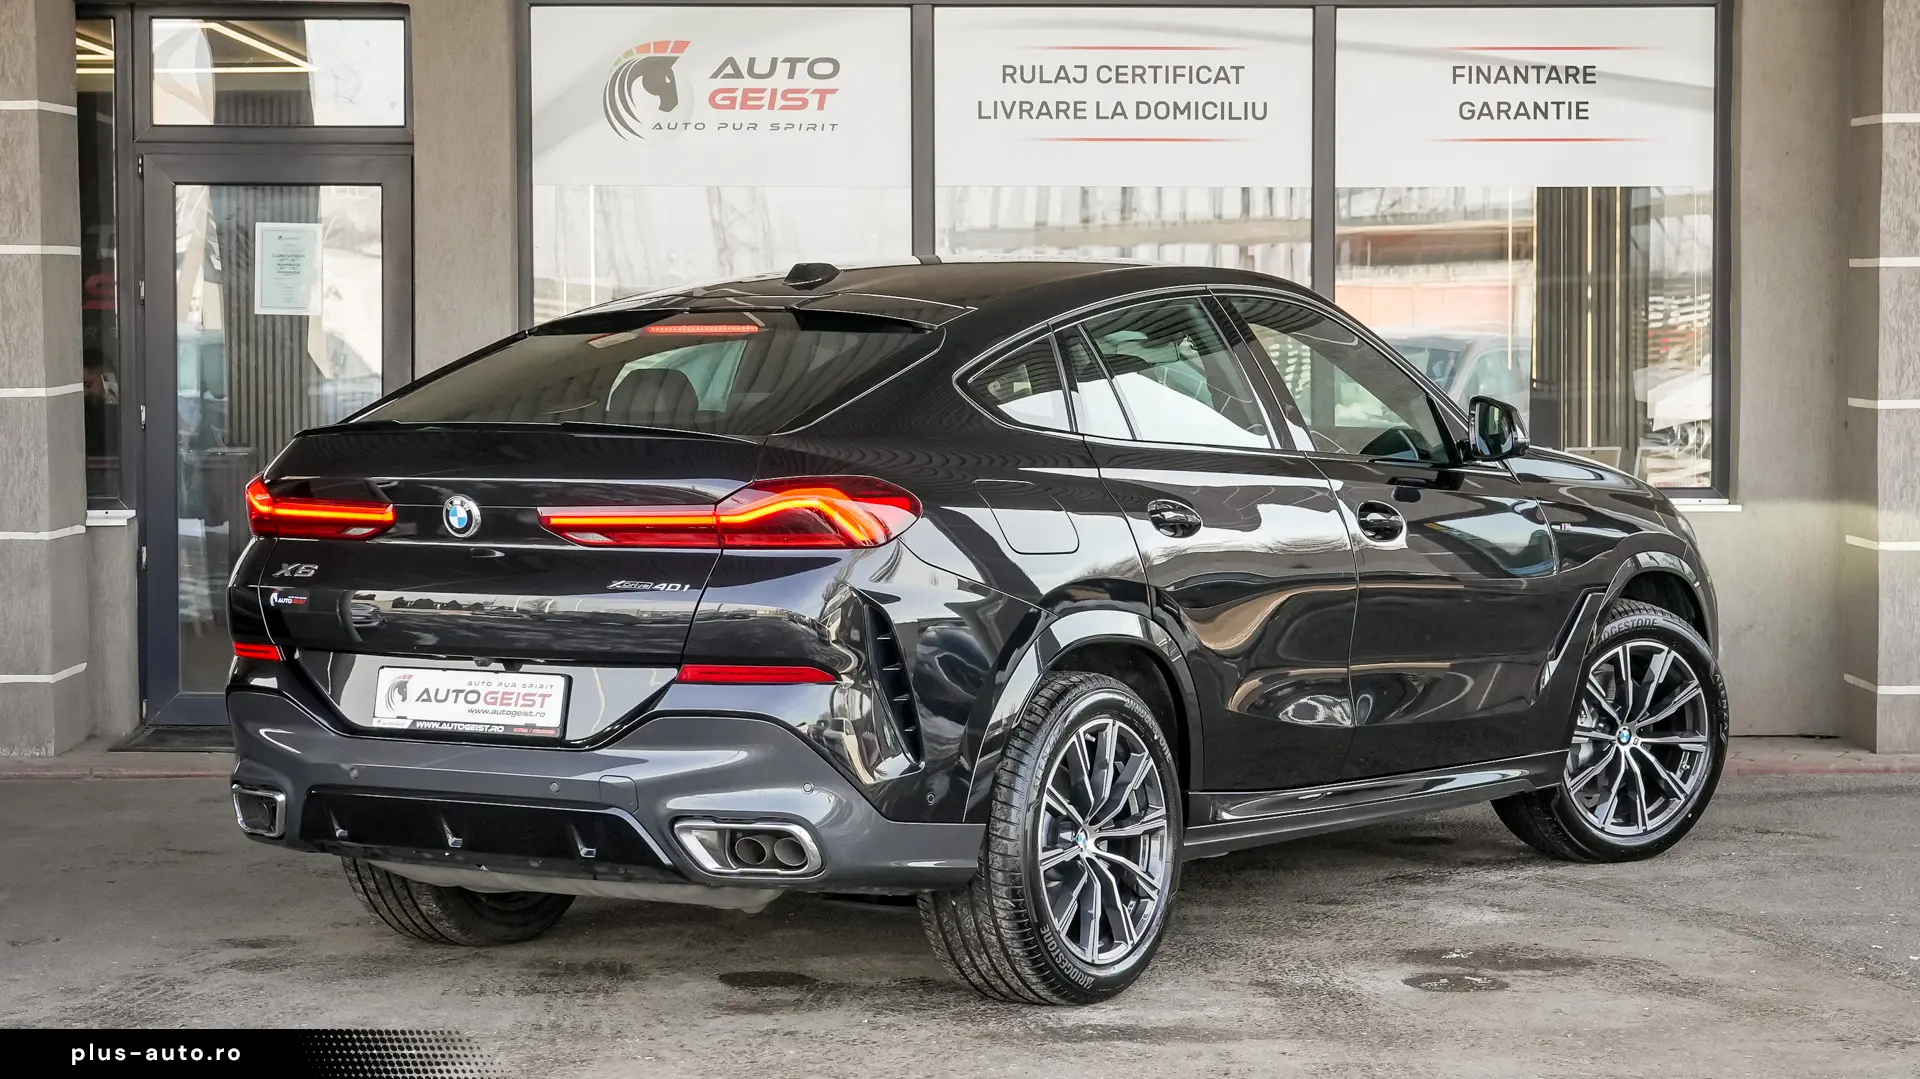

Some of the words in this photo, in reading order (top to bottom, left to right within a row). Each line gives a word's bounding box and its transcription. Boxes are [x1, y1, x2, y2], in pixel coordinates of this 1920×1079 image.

[708, 56, 841, 80] AUTO
[1001, 64, 1088, 84] RULAJ
[1096, 64, 1246, 85] CERTIFICAT
[1452, 65, 1597, 85] FINANTARE
[708, 87, 840, 111] GEIST
[977, 100, 1088, 120] LIVRARE
[1095, 100, 1129, 120] LA
[1135, 100, 1268, 121] DOMICILIU
[1458, 101, 1590, 121] GARANTIE
[651, 122, 706, 131] AUTO
[717, 122, 758, 131] PUR
[769, 123, 839, 132] SPIRIT
[271, 563, 319, 577] X6
[467, 707, 546, 718] www.autogeist.ro
[416, 721, 505, 733] WWW.AUTOGEIST.RO
[1040, 924, 1096, 990] BRIDGESTONE
